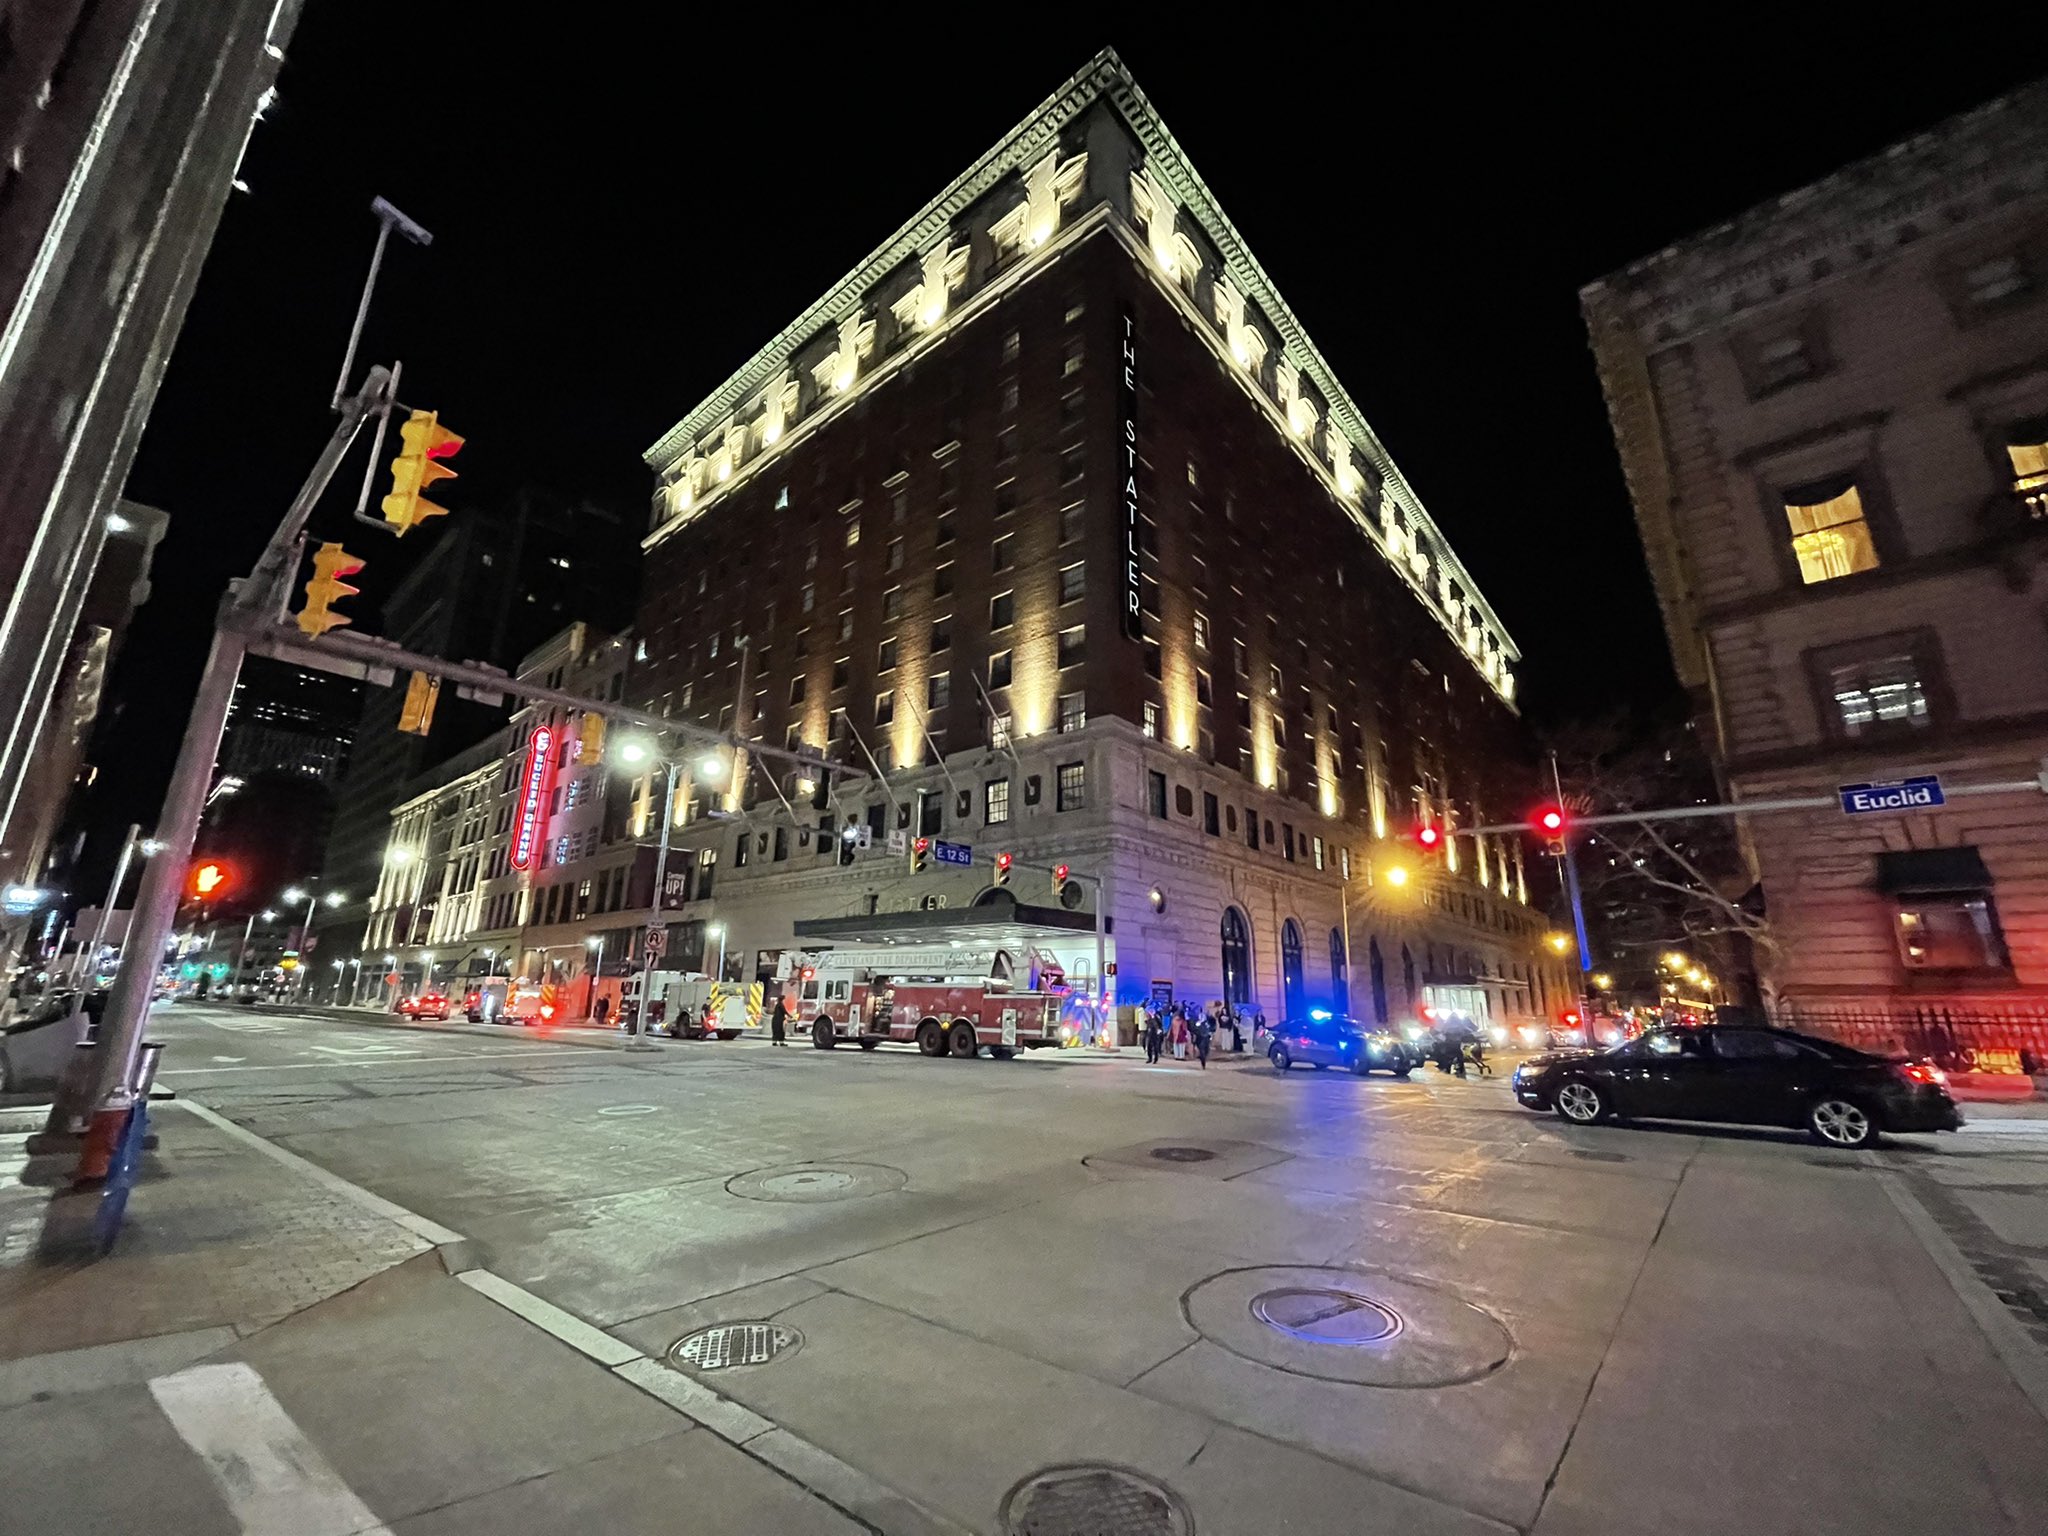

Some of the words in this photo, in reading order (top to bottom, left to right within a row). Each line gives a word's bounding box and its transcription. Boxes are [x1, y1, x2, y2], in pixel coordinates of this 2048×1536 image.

[1123, 315, 1135, 391] THE
[1125, 419, 1139, 616] STATLER
[1853, 787, 1932, 810] Euclid
[947, 849, 957, 861] 12
[958, 851, 969, 863] St
[665, 879, 686, 896] UP!
